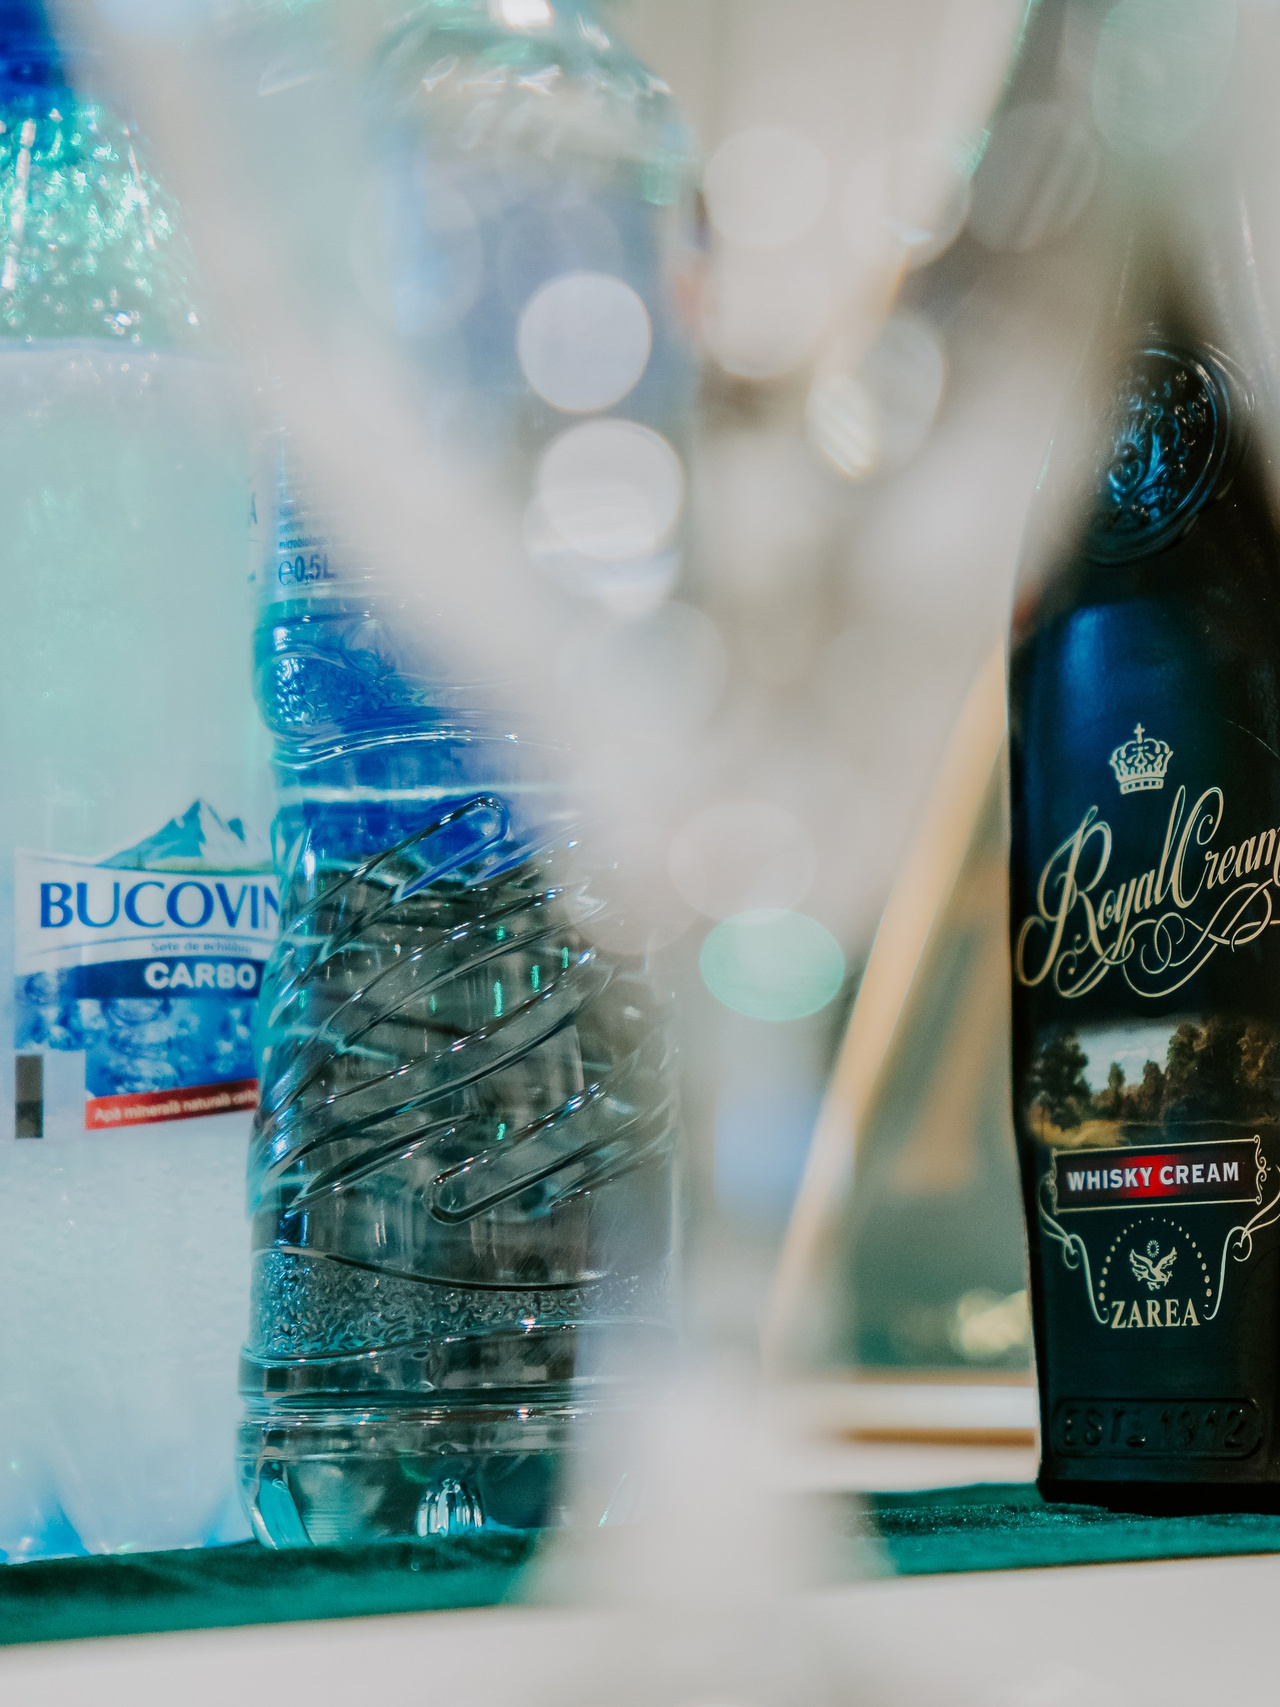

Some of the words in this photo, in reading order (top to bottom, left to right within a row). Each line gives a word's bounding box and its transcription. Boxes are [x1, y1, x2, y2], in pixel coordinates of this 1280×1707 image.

[39, 880, 279, 930] BUCOVIN
[1016, 785, 1186, 998] Royal
[144, 962, 257, 990] CARBO
[1066, 1165, 1153, 1191] WHISKY
[1159, 1161, 1239, 1186] CREAM
[1110, 1298, 1200, 1329] ZAREA
